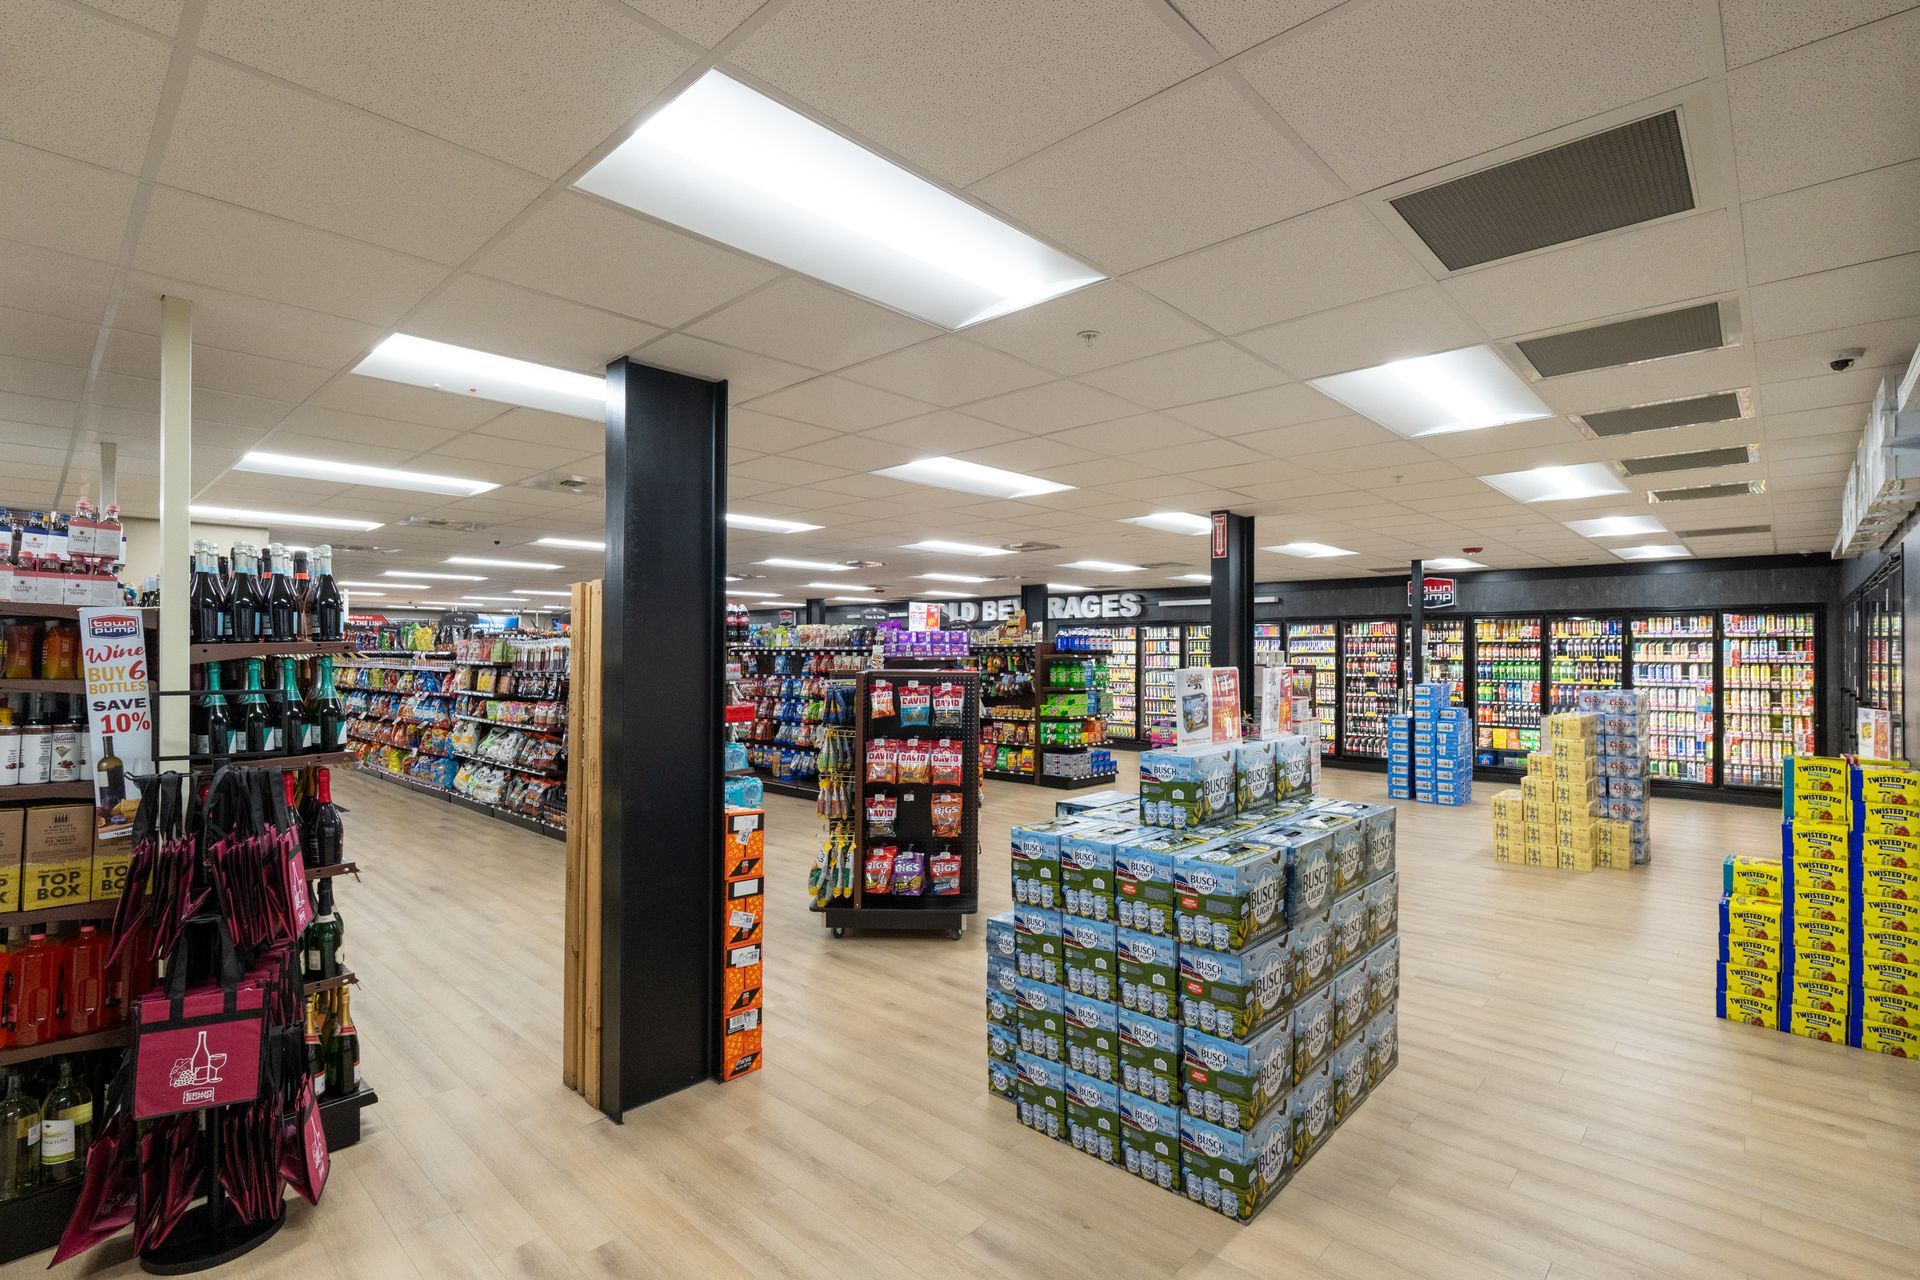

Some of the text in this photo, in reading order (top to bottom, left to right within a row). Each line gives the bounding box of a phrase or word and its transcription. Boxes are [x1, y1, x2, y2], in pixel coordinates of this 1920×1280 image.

[86, 644, 145, 664] Wine
[88, 660, 146, 682] BUY 6
[89, 681, 147, 694] BOTTLES
[93, 698, 146, 711] SAVE
[101, 712, 150, 734] 10%
[1153, 766, 1177, 776] BUSCH
[1286, 760, 1305, 775] BUSCH
[1829, 767, 1842, 775] TEA
[1248, 767, 1268, 784] BUSCH
[1205, 775, 1229, 796] BUSCH
[1905, 811, 1920, 819] TEA
[1830, 835, 1843, 843] TEA
[1902, 841, 1917, 850] TEA
[1023, 843, 1044, 853] BUSCH
[1074, 852, 1097, 862] BUSCH
[1340, 846, 1360, 868] BUSCH
[103, 865, 128, 878] TO
[1131, 862, 1156, 873] BUSCH
[1830, 865, 1844, 873] TEA
[38, 872, 80, 886] TOP
[102, 878, 126, 891] BO
[1190, 874, 1217, 888] BUSCH
[1302, 863, 1329, 894] BUSCH
[1766, 874, 1778, 882] TEA
[1903, 874, 1918, 882] TEA
[37, 883, 82, 900] BOX
[1251, 882, 1277, 912] BUSCH
[1308, 886, 1324, 901] LIGHT
[1832, 896, 1845, 904] TEA
[1256, 902, 1274, 917] LIGHT
[1868, 902, 1918, 914] TWISTED TEA
[1026, 916, 1047, 928] BUSCH
[1763, 915, 1776, 925] TEA
[1343, 916, 1362, 939] BUSCH
[1077, 930, 1099, 943] BUSCH
[1132, 944, 1156, 957] BUSCH
[1304, 935, 1328, 965] BUSCH
[1733, 941, 1776, 954] TWISTED TEA
[1799, 953, 1846, 966] TWISTED TEA
[1196, 960, 1222, 975] BUSCH
[1868, 964, 1918, 978] TWISTED TEA
[1256, 965, 1286, 997] BUSCH
[1027, 992, 1048, 1005] BUSCH
[1262, 988, 1280, 1004] LIGHT
[1345, 987, 1365, 1012] BUSCH
[1730, 998, 1773, 1012] TWISTED TEA
[1078, 1009, 1101, 1022] BUSCH
[1083, 1018, 1098, 1026] LIGHT
[1795, 1012, 1842, 1026] TWISTED TEA
[1134, 1026, 1158, 1042] BUSCH
[1305, 1013, 1329, 1045] BUSCH
[1867, 1026, 1917, 1041] TWISTED TEA
[1138, 1036, 1154, 1044] LIGHT
[1201, 1049, 1228, 1065] BUSCH
[1206, 1060, 1223, 1068] LIGHT
[1028, 1066, 1049, 1080] BUSCH
[1261, 1049, 1286, 1087] BUSCH
[1345, 1059, 1364, 1085] BUSCH
[1267, 1072, 1281, 1091] LIGHT
[1079, 1086, 1101, 1101] BUSCH
[1083, 1096, 1098, 1105] LIGHT
[1135, 1108, 1160, 1126] BUSCH
[1305, 1094, 1328, 1128] BUSCH
[1140, 1120, 1155, 1130] LIGHT
[1197, 1134, 1225, 1152] BUSCH
[1203, 1145, 1219, 1155] LIGHT
[1259, 1136, 1286, 1174] BUSCH
[1266, 1158, 1282, 1178] LIGHT
